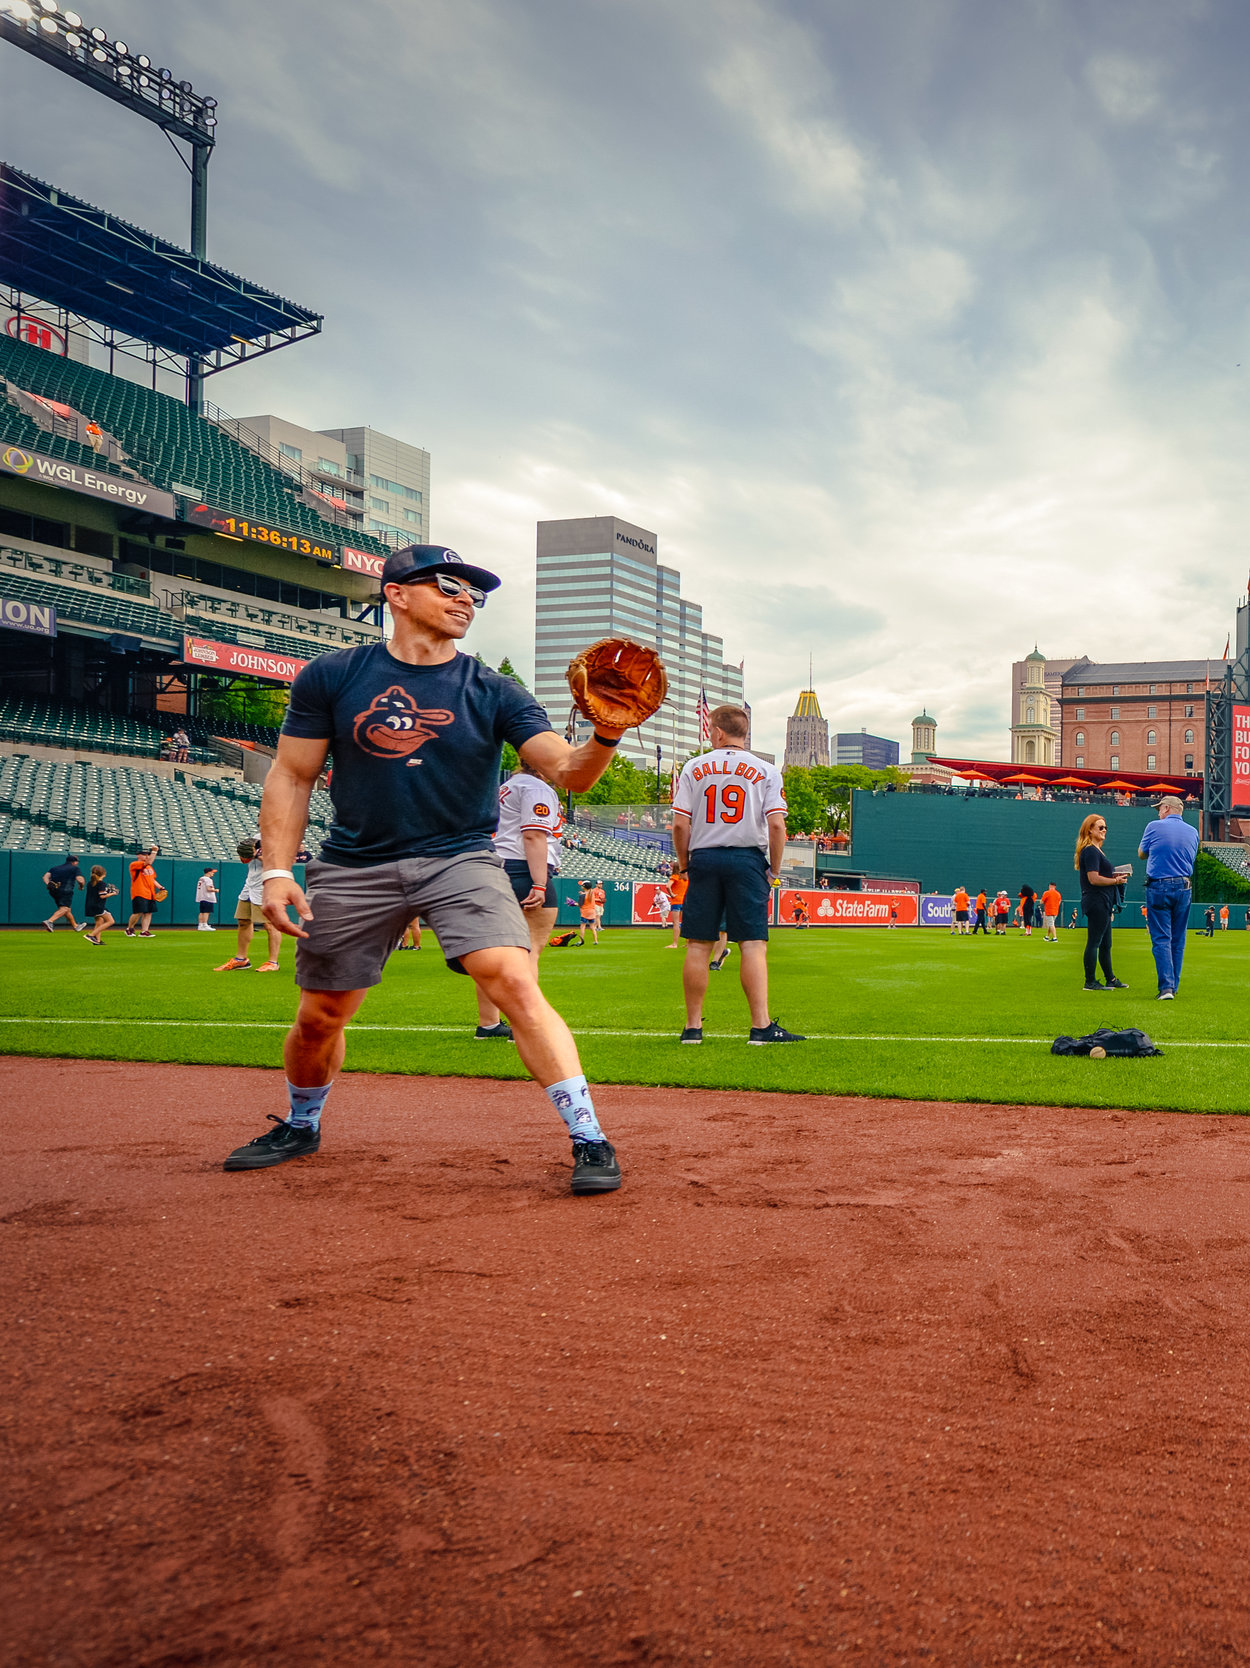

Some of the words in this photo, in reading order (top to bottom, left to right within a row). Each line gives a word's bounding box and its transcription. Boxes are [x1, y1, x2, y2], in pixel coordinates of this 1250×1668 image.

[36, 459, 82, 485] WGL
[84, 473, 148, 505] Energy
[226, 518, 311, 554] 11:36:13
[312, 546, 332, 560] AM
[230, 652, 296, 677] JOHNSON
[692, 760, 732, 782] BALL
[734, 762, 766, 785] BOY
[535, 805, 549, 815] 20
[704, 784, 746, 824] 19
[613, 881, 630, 892] 364
